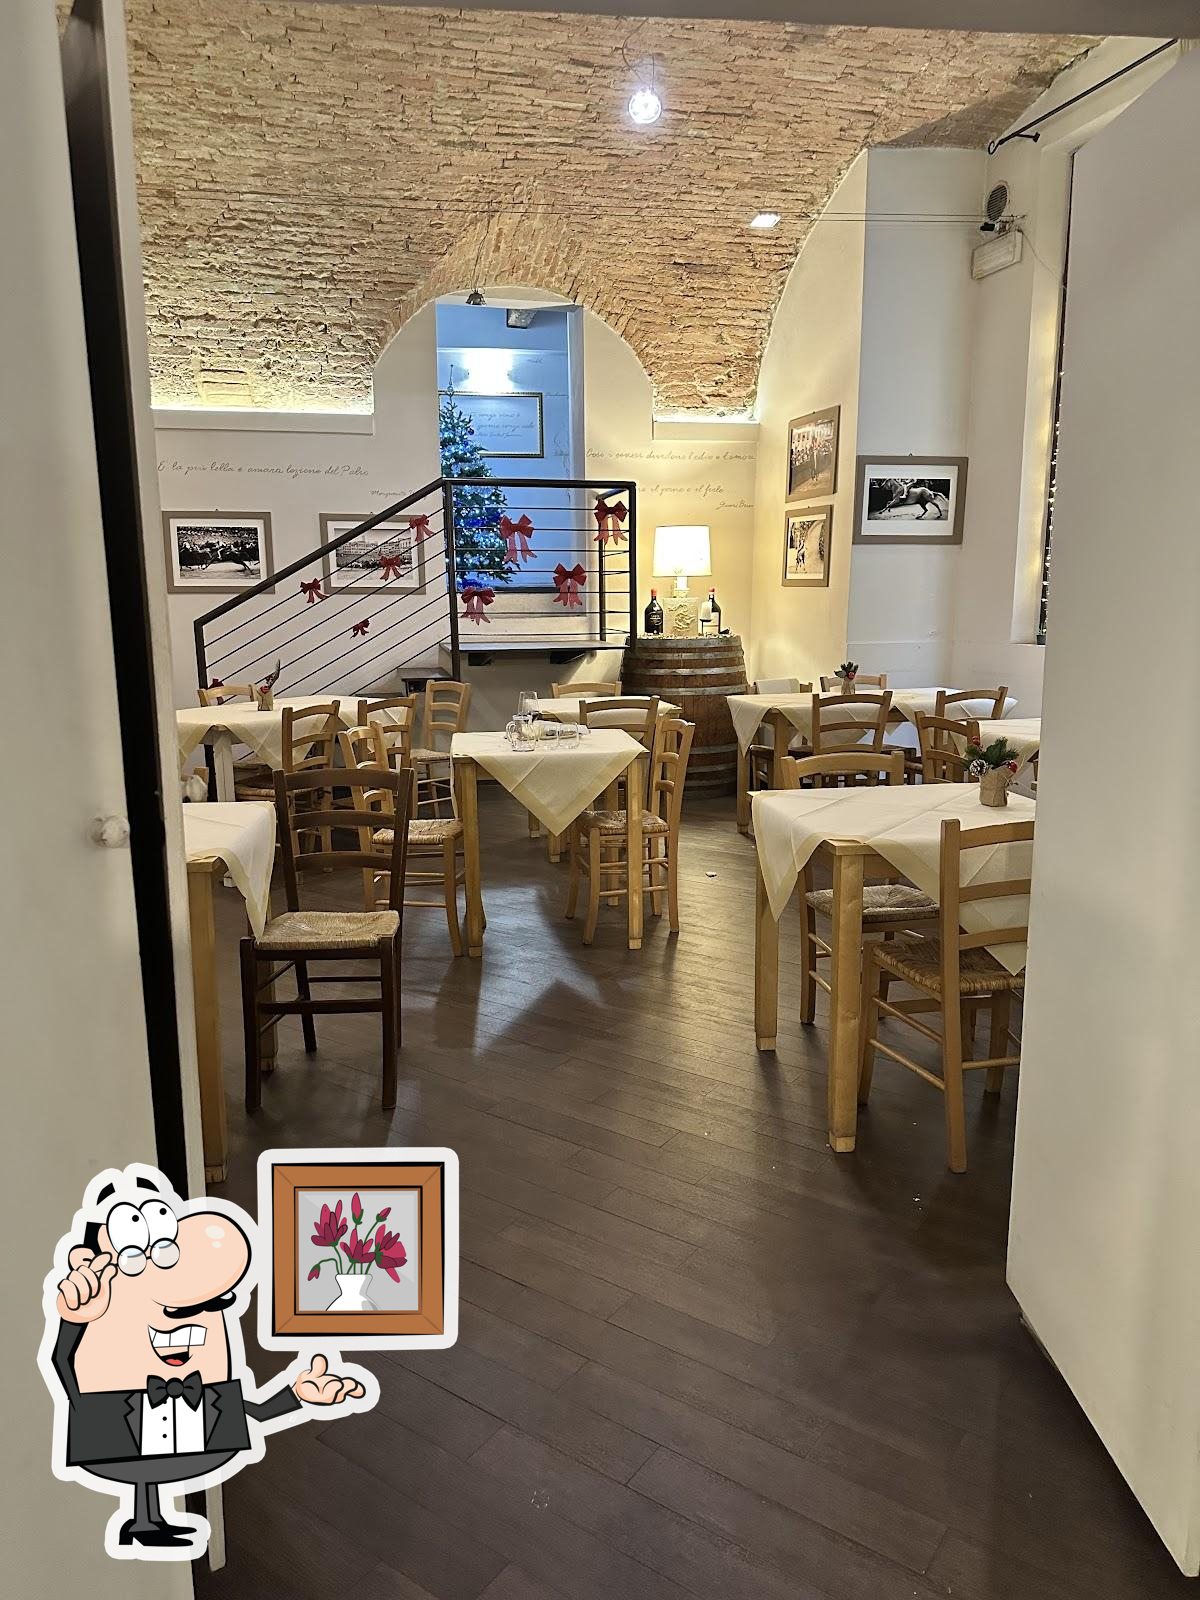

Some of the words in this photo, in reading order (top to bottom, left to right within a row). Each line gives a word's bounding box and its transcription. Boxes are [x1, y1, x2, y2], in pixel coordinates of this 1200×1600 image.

[172, 461, 183, 472] la
[247, 465, 284, 475] amara
[286, 464, 322, 479] lezione
[324, 464, 340, 476] del
[340, 463, 369, 477] Palio
